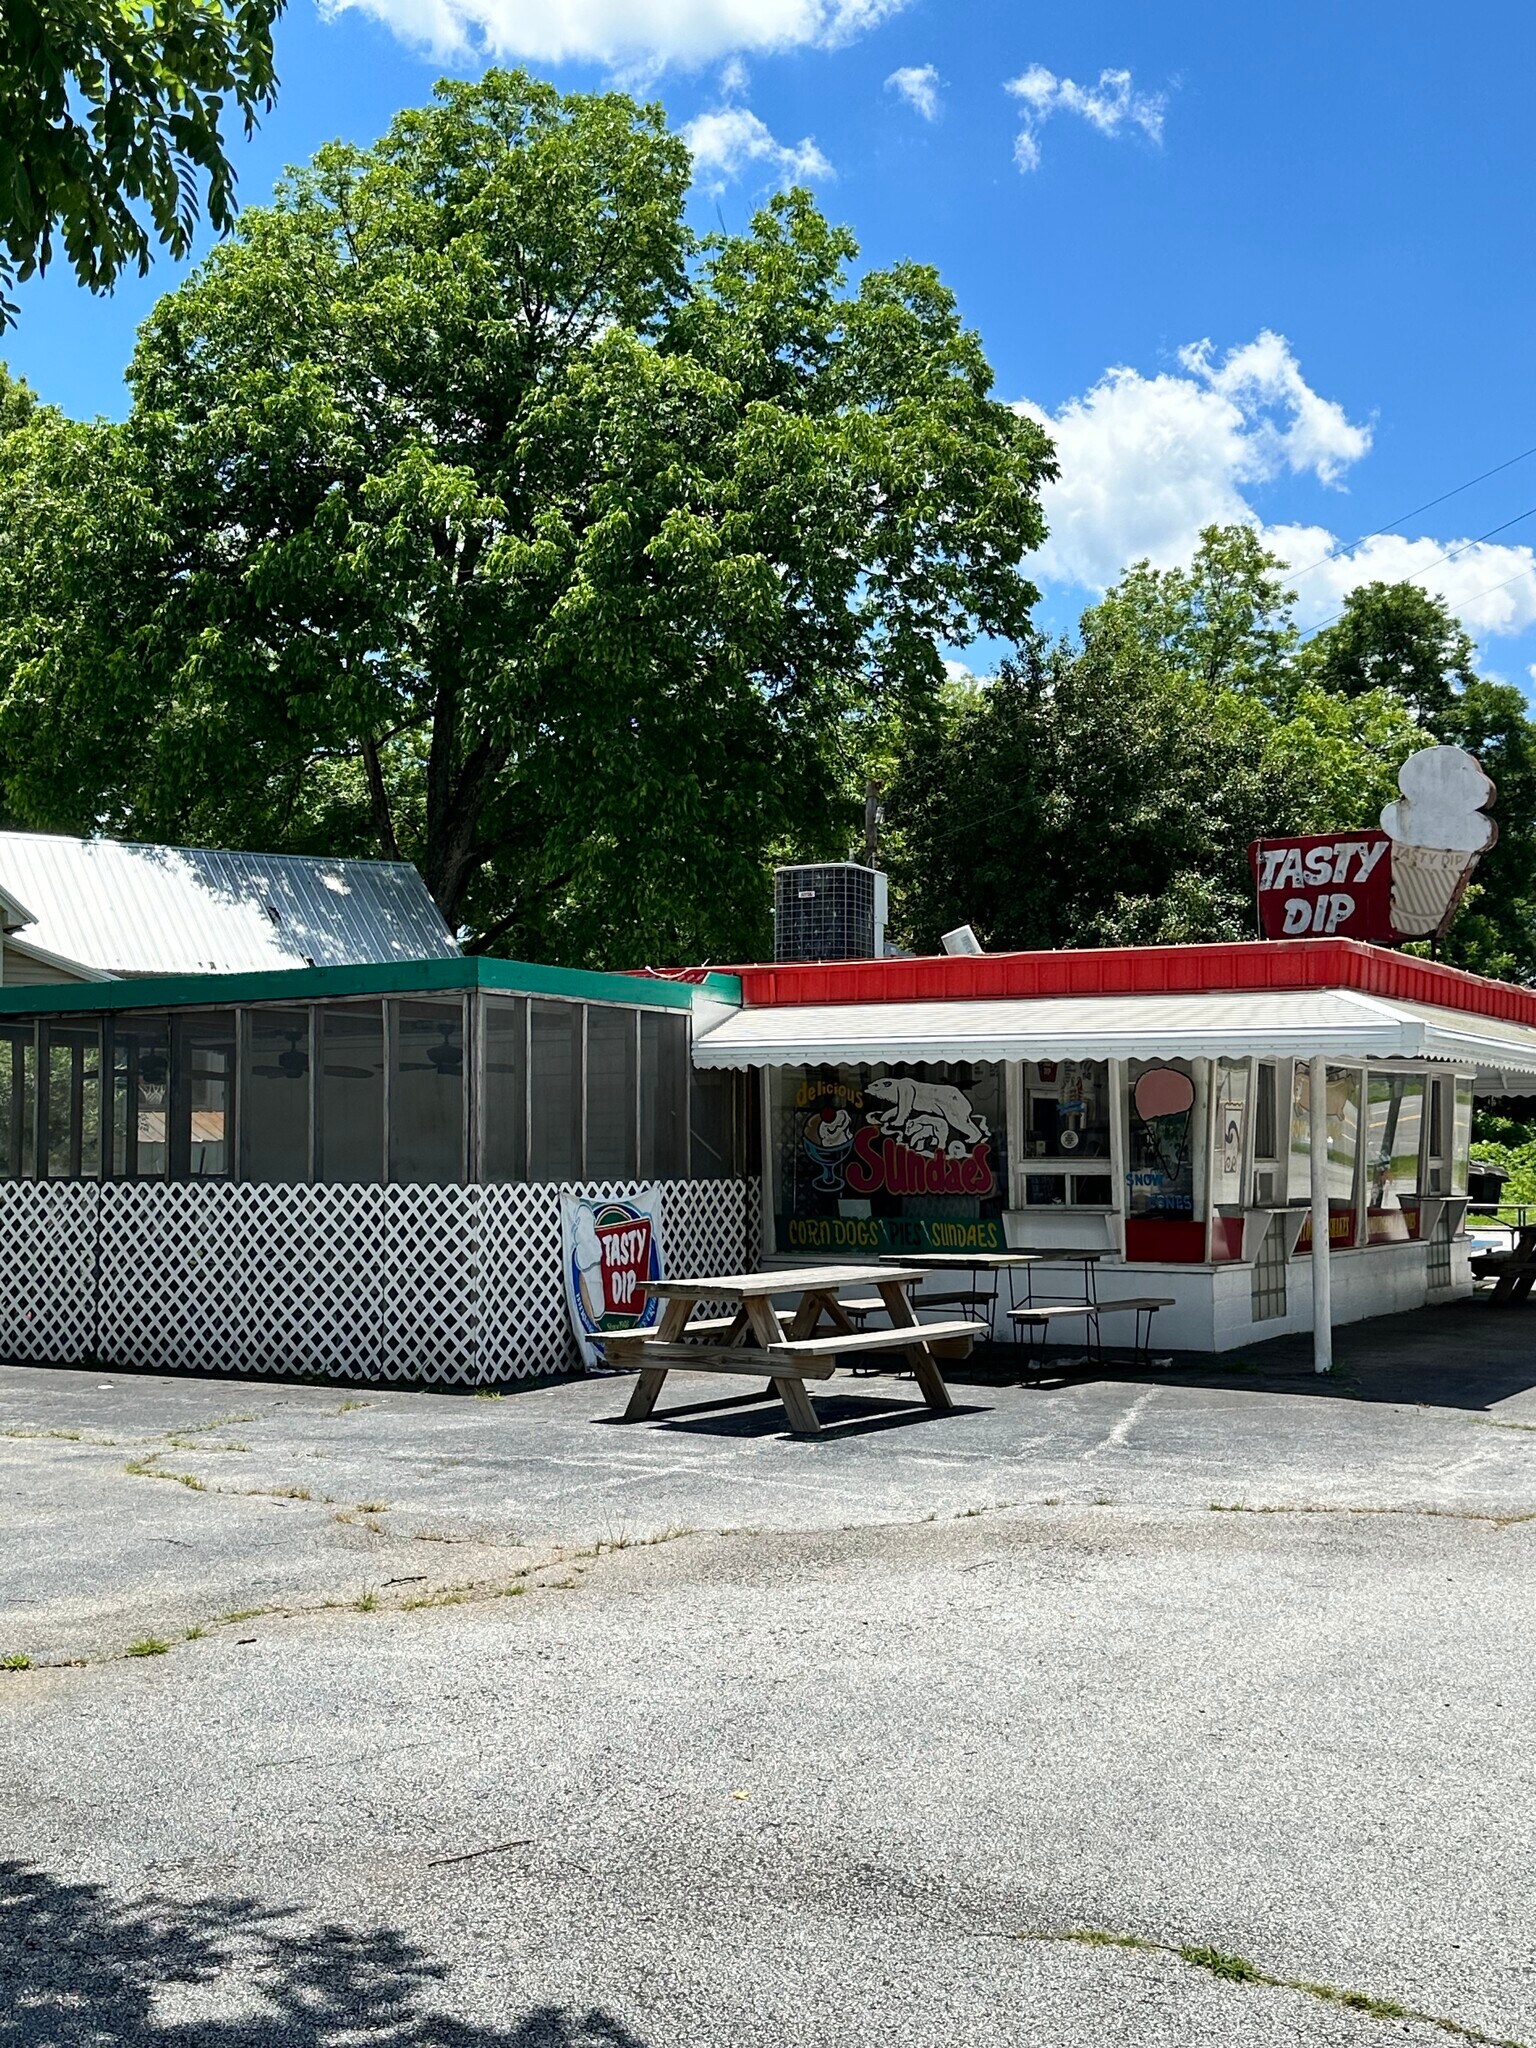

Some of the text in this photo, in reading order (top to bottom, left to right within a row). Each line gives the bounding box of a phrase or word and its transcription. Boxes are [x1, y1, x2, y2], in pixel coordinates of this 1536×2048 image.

[1258, 841, 1390, 891] TASTY
[1397, 846, 1464, 866] TASTY DIP
[1282, 893, 1356, 934] DIP
[796, 1081, 864, 1109] delicious
[846, 1126, 993, 1195] Sundaes
[1126, 1173, 1165, 1187] SNOW
[602, 1228, 647, 1267] TASTY
[788, 1219, 998, 1248] CORN DOGS PIES SUNDAES
[612, 1269, 636, 1304] DIP
